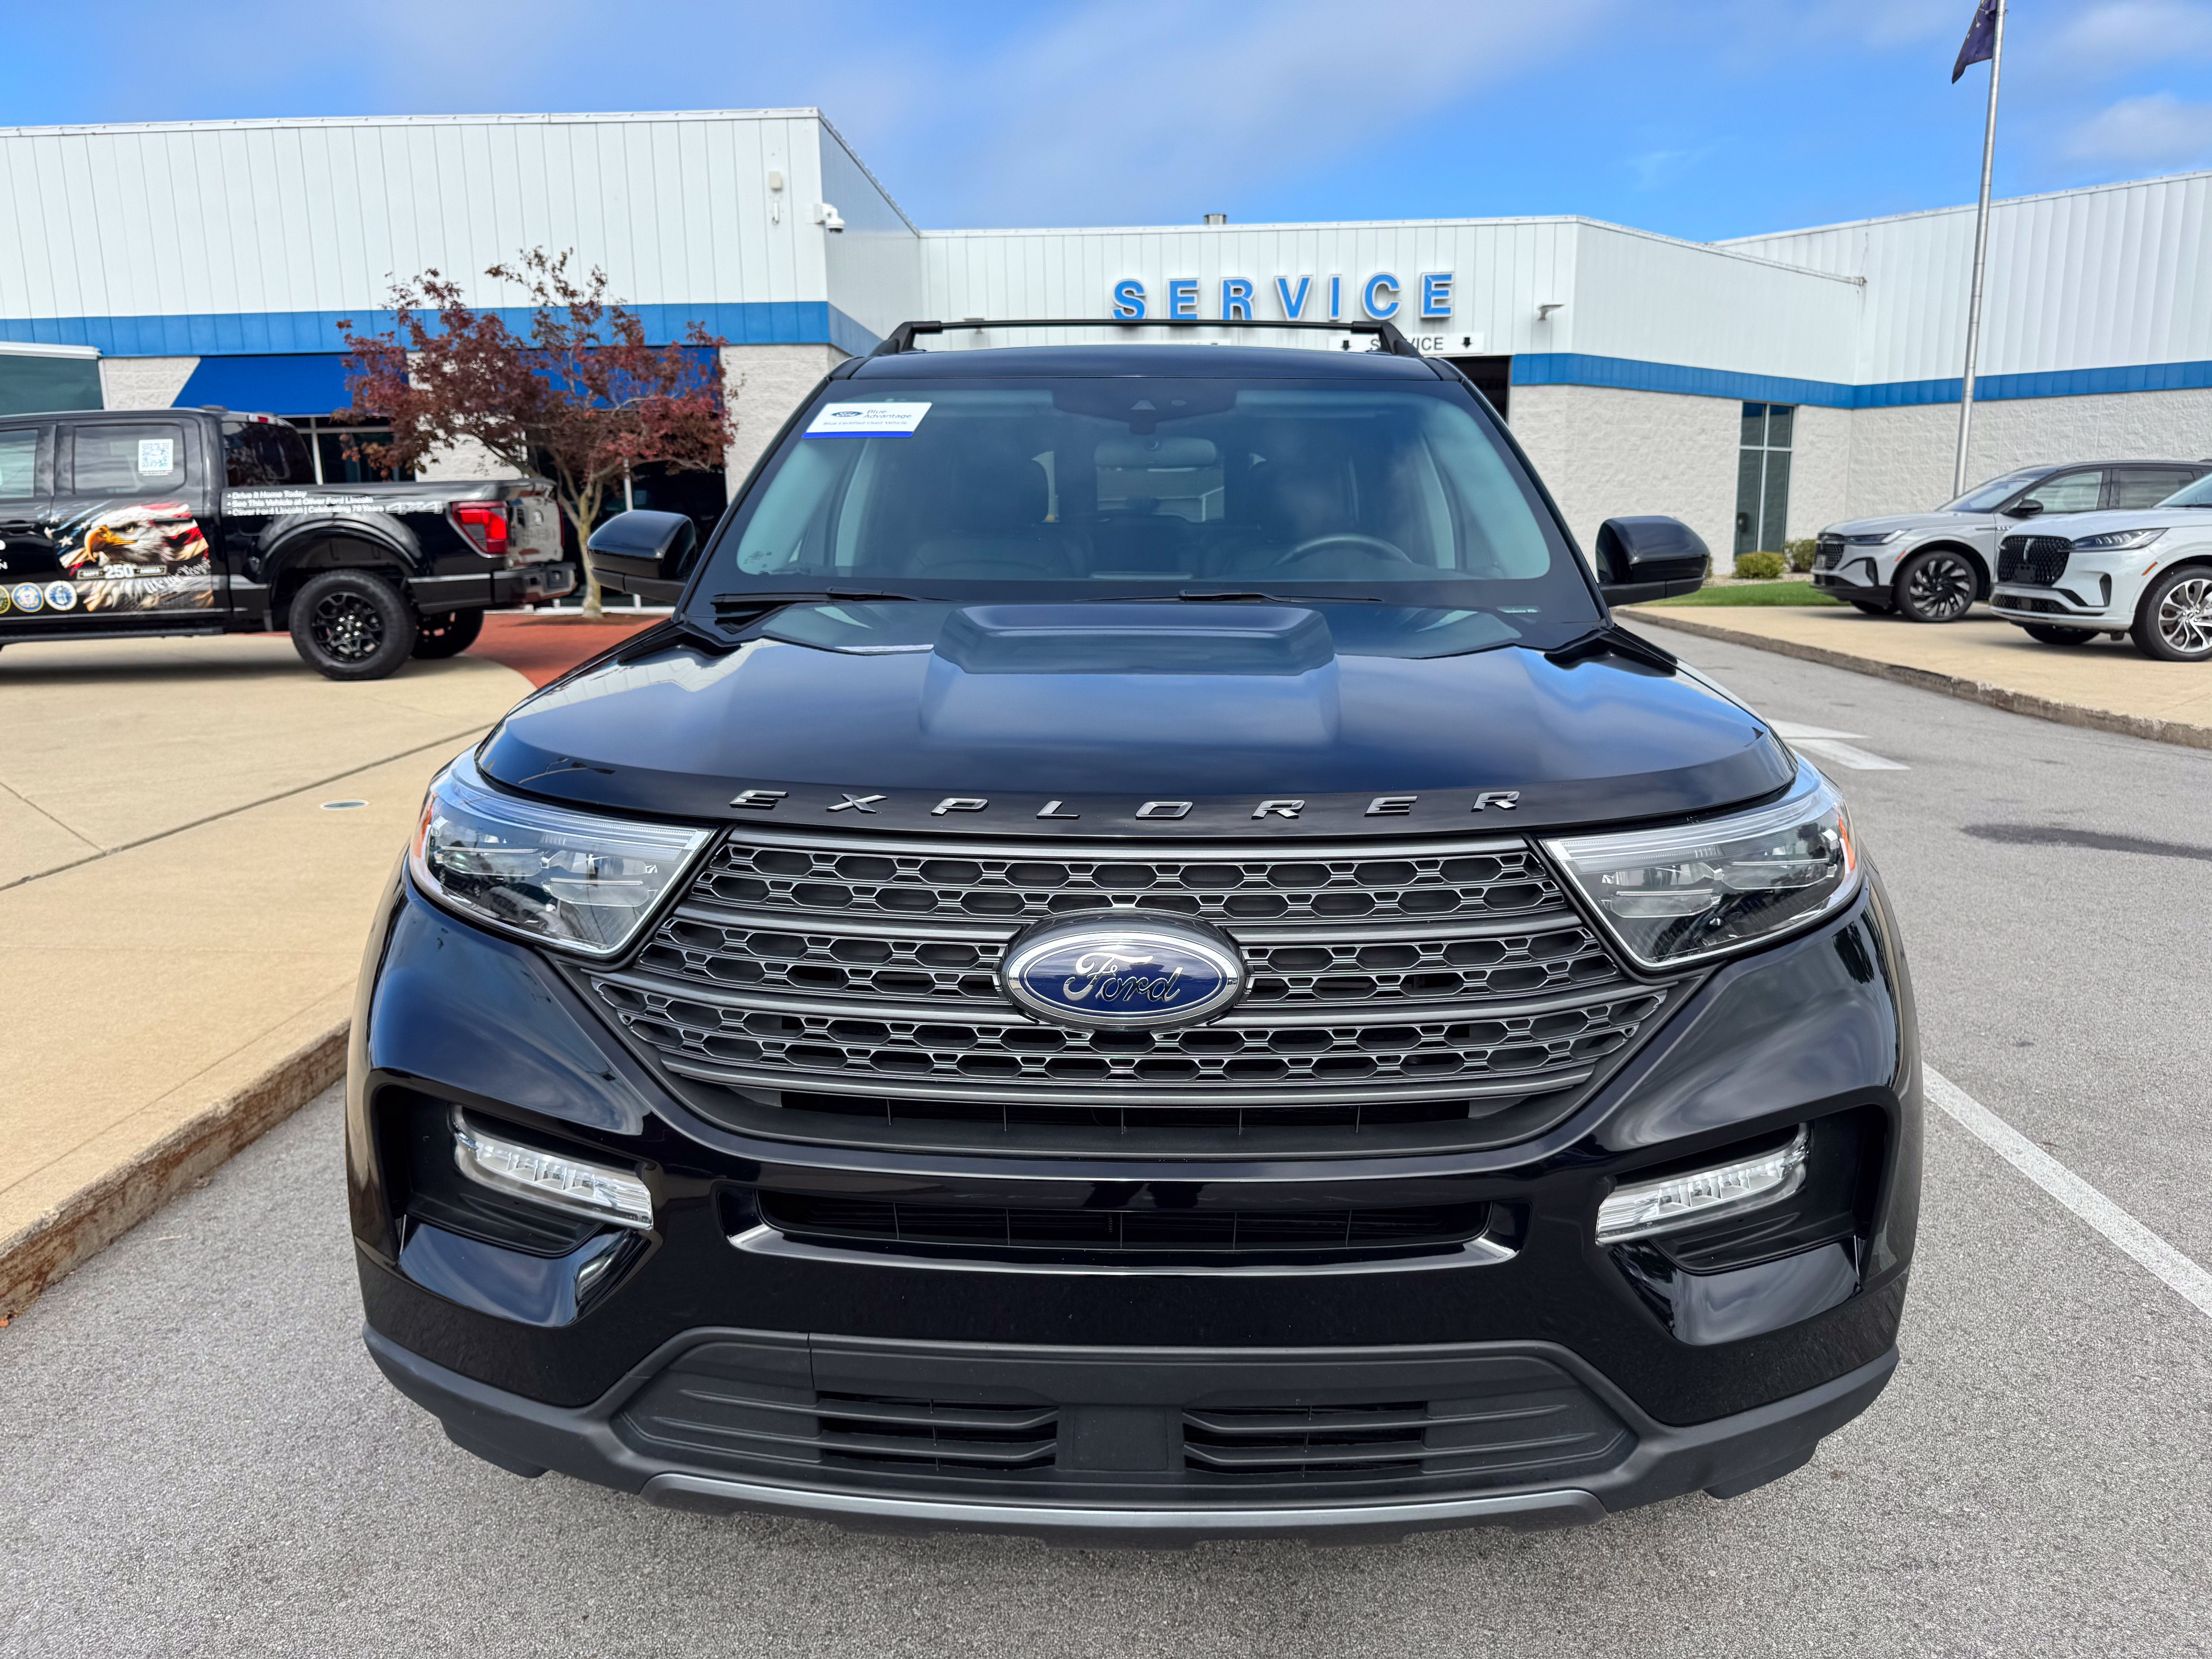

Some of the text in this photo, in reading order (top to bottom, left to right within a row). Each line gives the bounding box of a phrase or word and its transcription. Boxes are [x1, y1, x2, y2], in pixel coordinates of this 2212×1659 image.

[1111, 272, 1453, 320] SERVICE
[1370, 337, 1443, 350] SICE
[283, 490, 307, 498] Today
[275, 506, 304, 515] Lincoln
[103, 564, 135, 579] 250
[729, 790, 1520, 821] EXPLORER
[1063, 952, 1183, 1001] Ford
